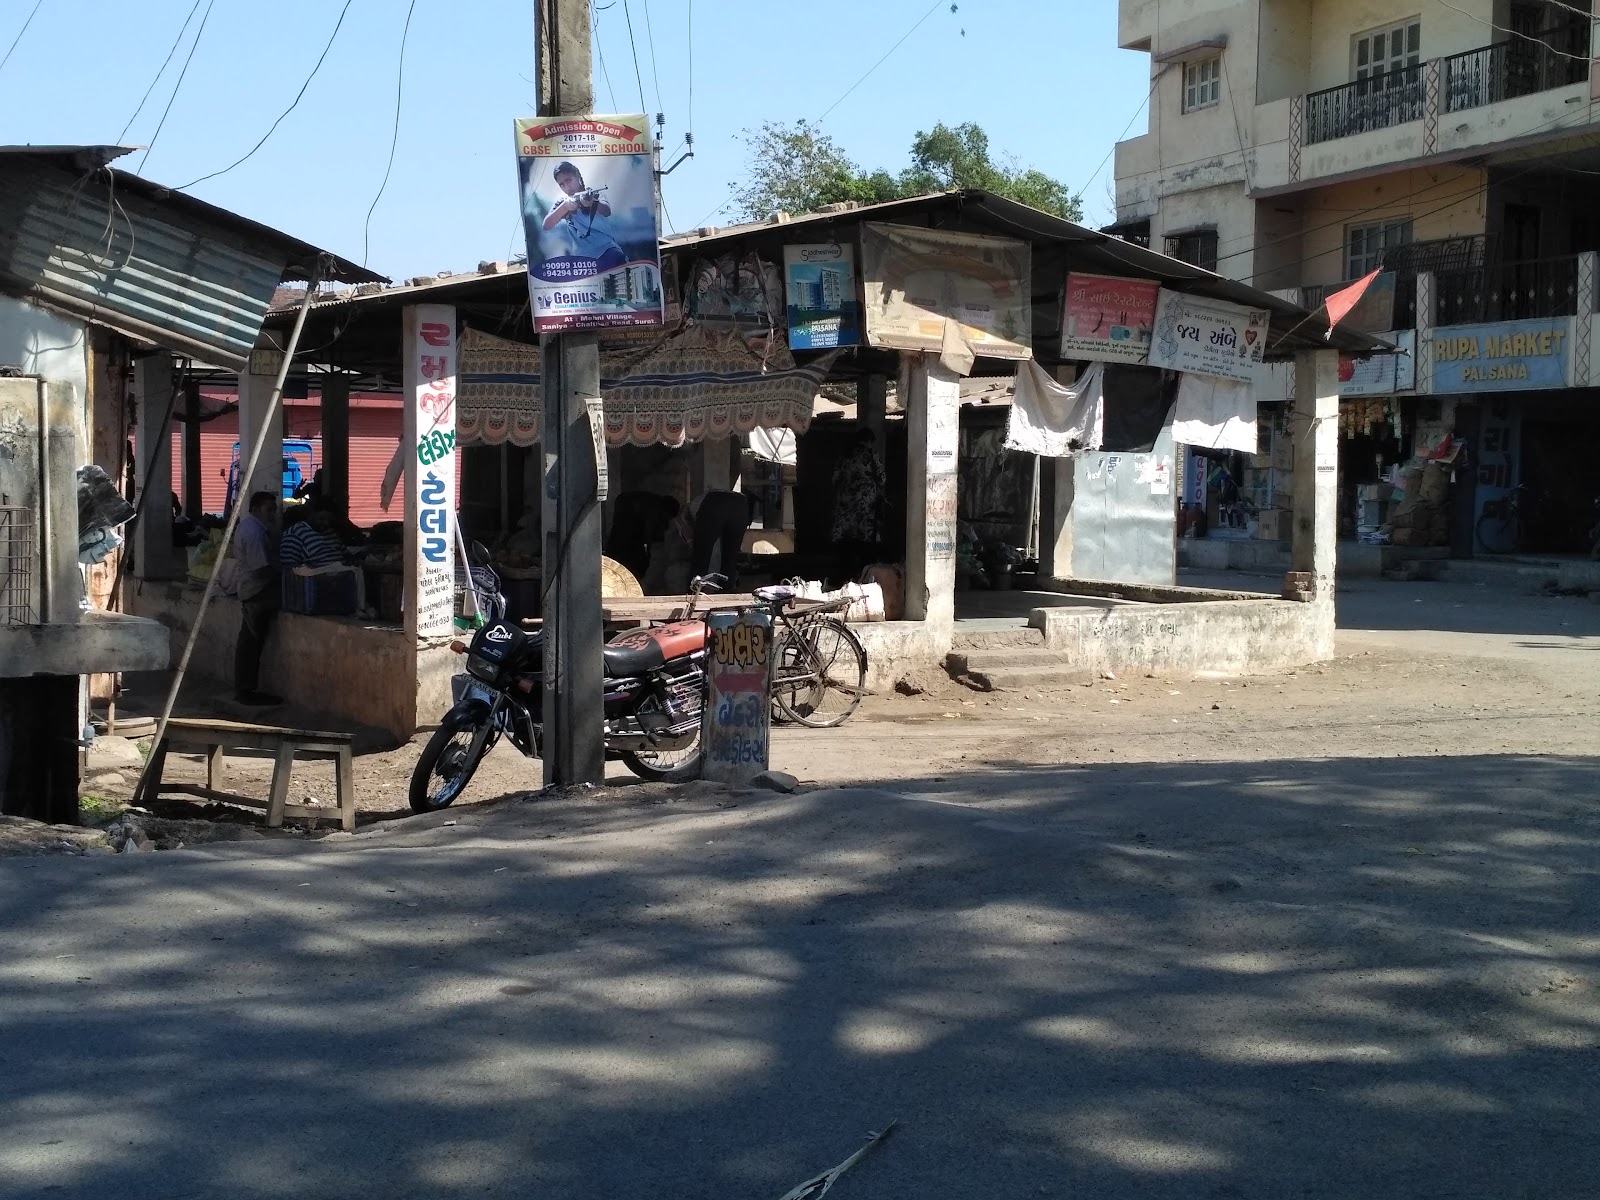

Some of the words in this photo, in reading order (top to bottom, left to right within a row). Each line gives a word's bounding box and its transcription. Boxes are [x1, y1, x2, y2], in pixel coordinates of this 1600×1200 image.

[544, 122, 593, 136] Admission
[596, 122, 621, 136] Open
[563, 134, 595, 142] 2017-18
[523, 145, 551, 155] CBSE
[604, 143, 647, 154] SCHOOL
[546, 262, 571, 270] 90999
[573, 261, 597, 269] 10106
[546, 269, 571, 277] 94294
[573, 268, 598, 276] 87733
[554, 290, 598, 304] Genius
[1177, 324, 1200, 342] જય
[1209, 327, 1237, 348] અંબે
[1435, 335, 1480, 363] RUPA
[1485, 329, 1566, 359] MARKET
[1462, 362, 1528, 382] PALSANA
